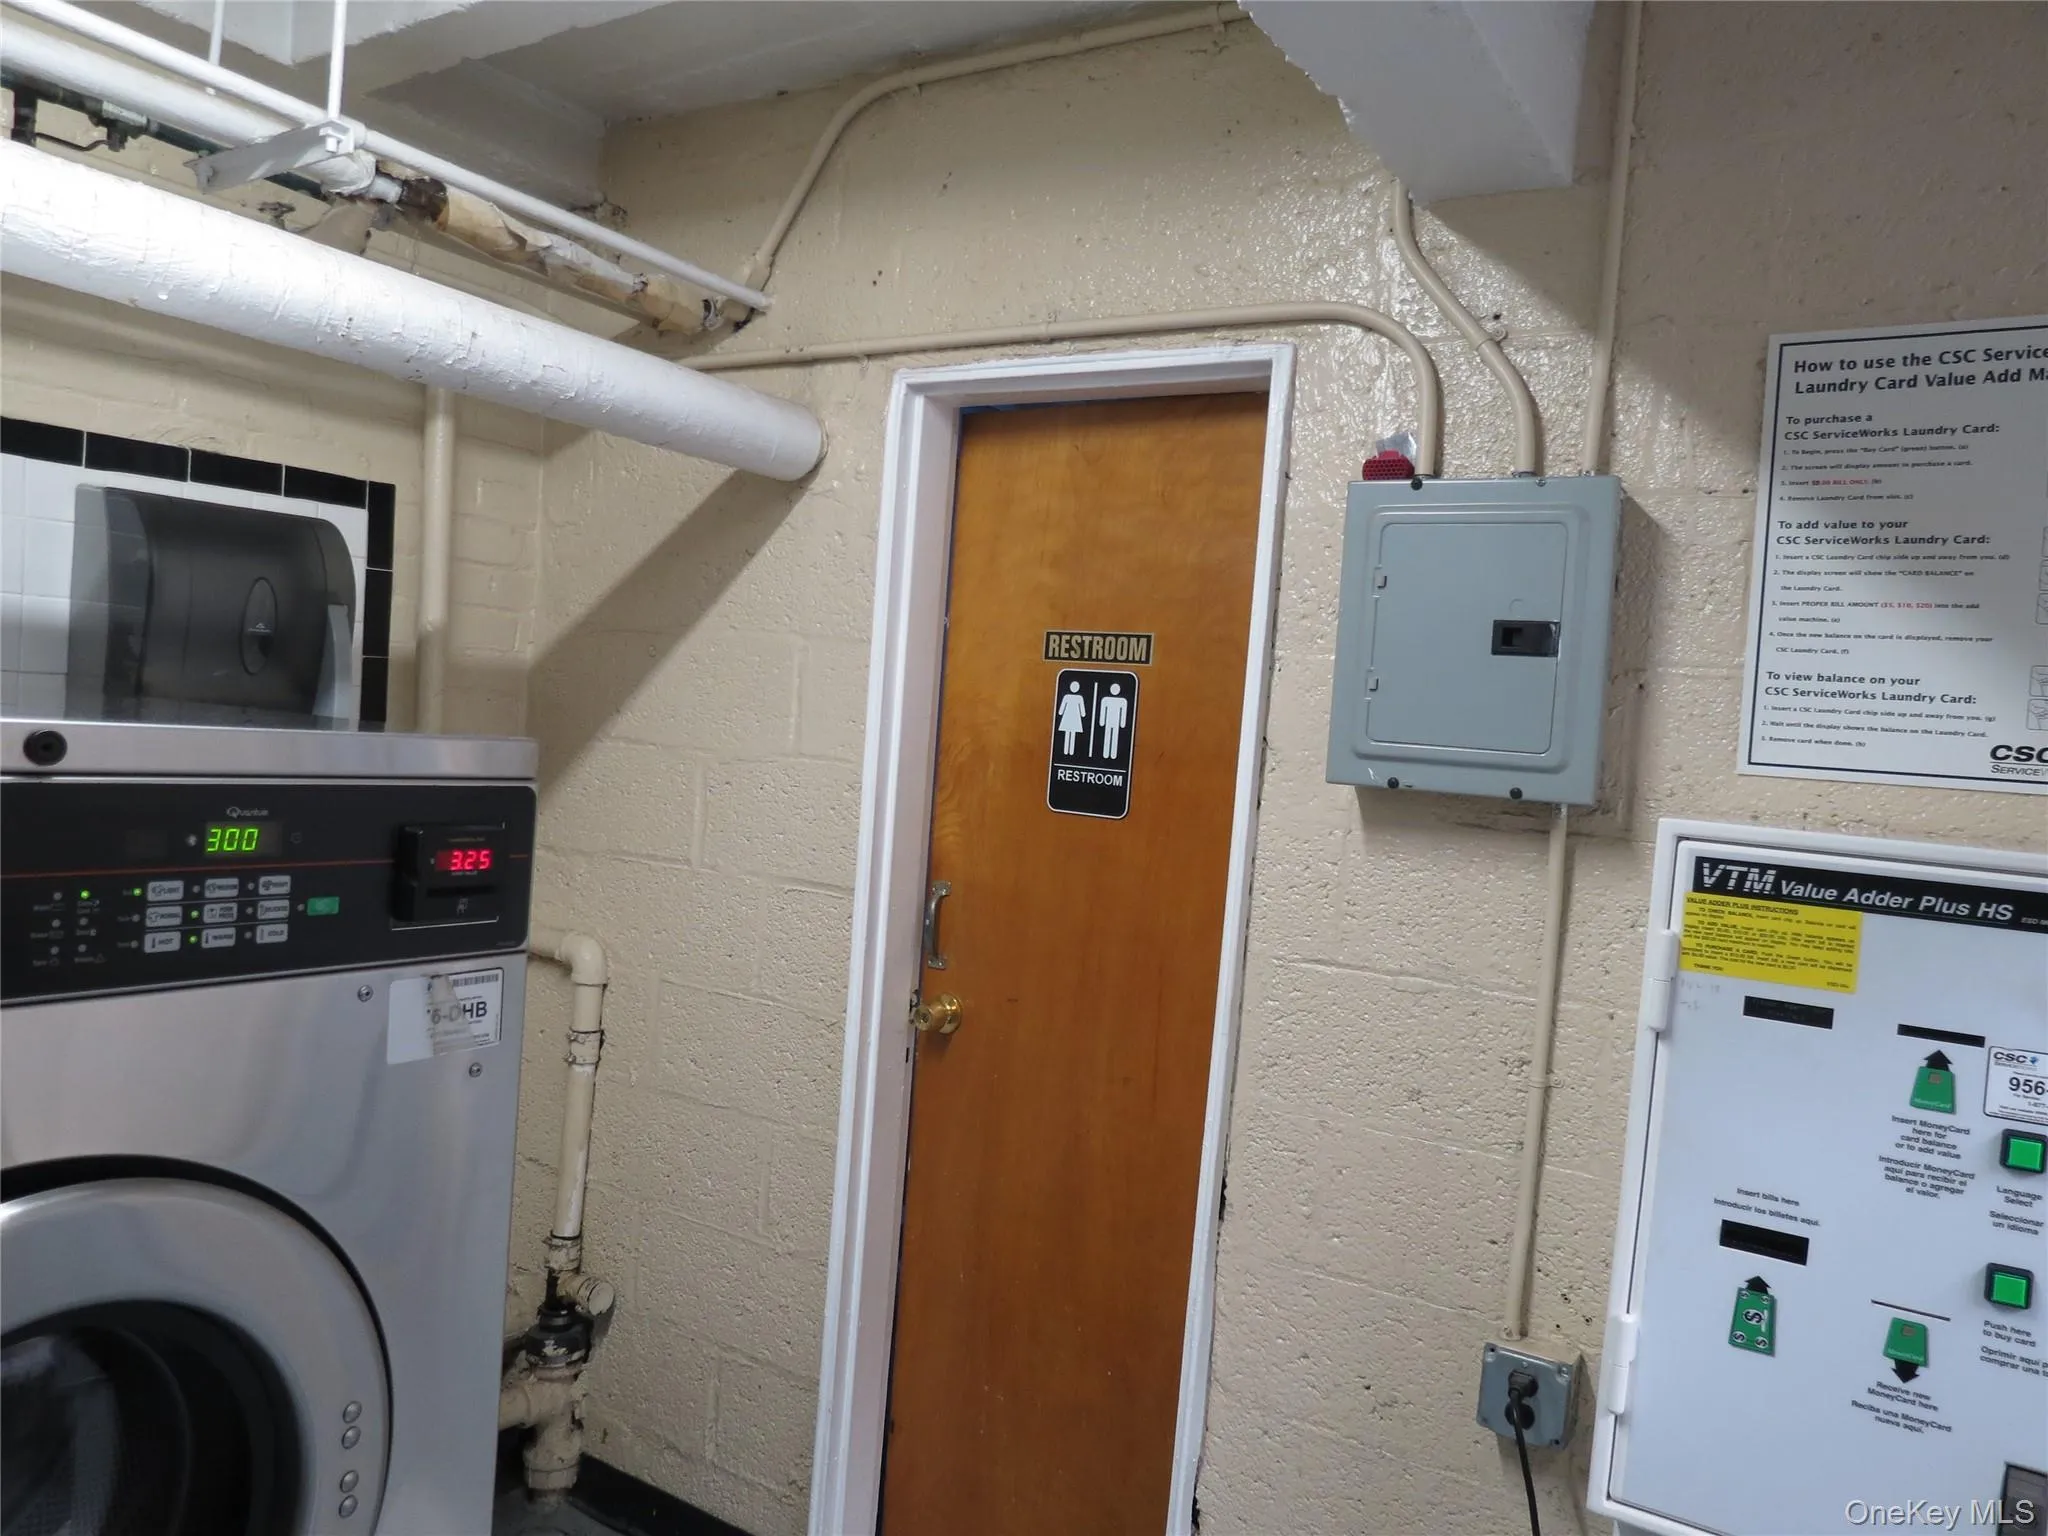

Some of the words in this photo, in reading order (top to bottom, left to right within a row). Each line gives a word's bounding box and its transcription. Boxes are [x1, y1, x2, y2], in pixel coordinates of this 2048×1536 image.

[1794, 359, 1833, 373] How
[1839, 359, 1857, 370] to
[1863, 357, 1895, 369] use
[1902, 352, 1932, 367] the
[1938, 348, 1976, 365] CSC
[1795, 378, 1868, 394] Laundry
[1874, 374, 1918, 390] Card
[1925, 371, 1976, 387] Value
[1982, 367, 2021, 384] Add
[2028, 367, 2048, 381] M
[1786, 416, 1800, 424] To
[1804, 414, 1861, 426] purchase
[1784, 430, 1808, 440] CSC
[1812, 427, 1898, 439] ServiceWorks
[1903, 425, 1958, 436] Laundry
[1962, 423, 1999, 434] Card:
[1778, 520, 1792, 529] To
[1795, 519, 1819, 529] add
[1823, 519, 1857, 529] value
[1879, 521, 1908, 530] your
[1776, 535, 1800, 544] CSC
[1804, 535, 1889, 545] ServiceWorks
[1894, 535, 1949, 545] Laundry
[1953, 534, 1990, 544] Card:
[1048, 634, 1147, 661] RESTROOM
[1767, 671, 1780, 680] To
[1784, 671, 1813, 681] view
[1816, 672, 1865, 683] balance
[1890, 677, 1920, 686] your
[1764, 686, 1789, 696] CSC
[1792, 687, 1876, 700] ServiceWorks
[1881, 691, 1936, 704] Laundry
[1940, 693, 1976, 704] Card:
[1057, 769, 1123, 787] RESTROOM
[207, 827, 259, 852] 300
[1702, 862, 1777, 894] VTM
[1781, 880, 1838, 901] Value
[1842, 887, 1913, 908] Adder
[1918, 895, 1970, 915] Plus
[1977, 902, 2013, 920] HS
[1686, 897, 1707, 905] VALUE
[1706, 899, 1731, 908] ADDER
[1731, 901, 1749, 910] PLUS
[1750, 904, 1798, 915] INSTRUCTIONS
[1993, 1051, 2028, 1063] CSC
[1891, 1115, 1917, 1128] Insert
[1918, 1119, 1970, 1135] MoneyCard
[1911, 1127, 1932, 1137] here
[1933, 1131, 1947, 1139] for
[1900, 1134, 1920, 1143] card
[1921, 1137, 1957, 1150] balance
[1905, 1143, 1916, 1151] to
[1916, 1146, 1934, 1154] add
[1936, 1150, 1961, 1159] value
[1878, 1155, 1921, 1169] Introducir
[1923, 1163, 1975, 1180] MoneyCard
[1904, 1169, 1925, 1178] para
[1927, 1174, 1956, 1184] recibir
[1884, 1173, 1919, 1188] balance
[1920, 1181, 1927, 1190] o
[1929, 1183, 1964, 1194] agregar
[1736, 1187, 1760, 1198] Insert
[1761, 1192, 1779, 1202] bills
[1780, 1197, 1800, 1206] here
[1996, 1185, 2043, 1201] Language
[2003, 1195, 2033, 1207] Select
[1713, 1197, 1752, 1211] Introducir
[1754, 1206, 1767, 1214] los
[1768, 1209, 1798, 1222] billetes
[1989, 1210, 2044, 1227] Seleccionar
[2006, 1223, 2039, 1235] idioma
[1983, 1319, 2008, 1331] Push
[2009, 1326, 2031, 1337] here
[1993, 1331, 2012, 1342] buy
[2014, 1337, 2036, 1347] card
[1980, 1345, 2017, 1360] Oprimir
[1979, 1355, 2020, 1369] comprar
[2021, 1366, 2040, 1375] una
[1867, 1387, 1916, 1406] MoneyCard
[1917, 1400, 1938, 1411] here
[1876, 1381, 1911, 1396] Receive
[1912, 1391, 1931, 1401] new
[1851, 1399, 1881, 1413] Reciba
[1882, 1409, 1899, 1418] una
[1900, 1412, 1952, 1432] MoneyCard
[1875, 1415, 1901, 1427] nueva
